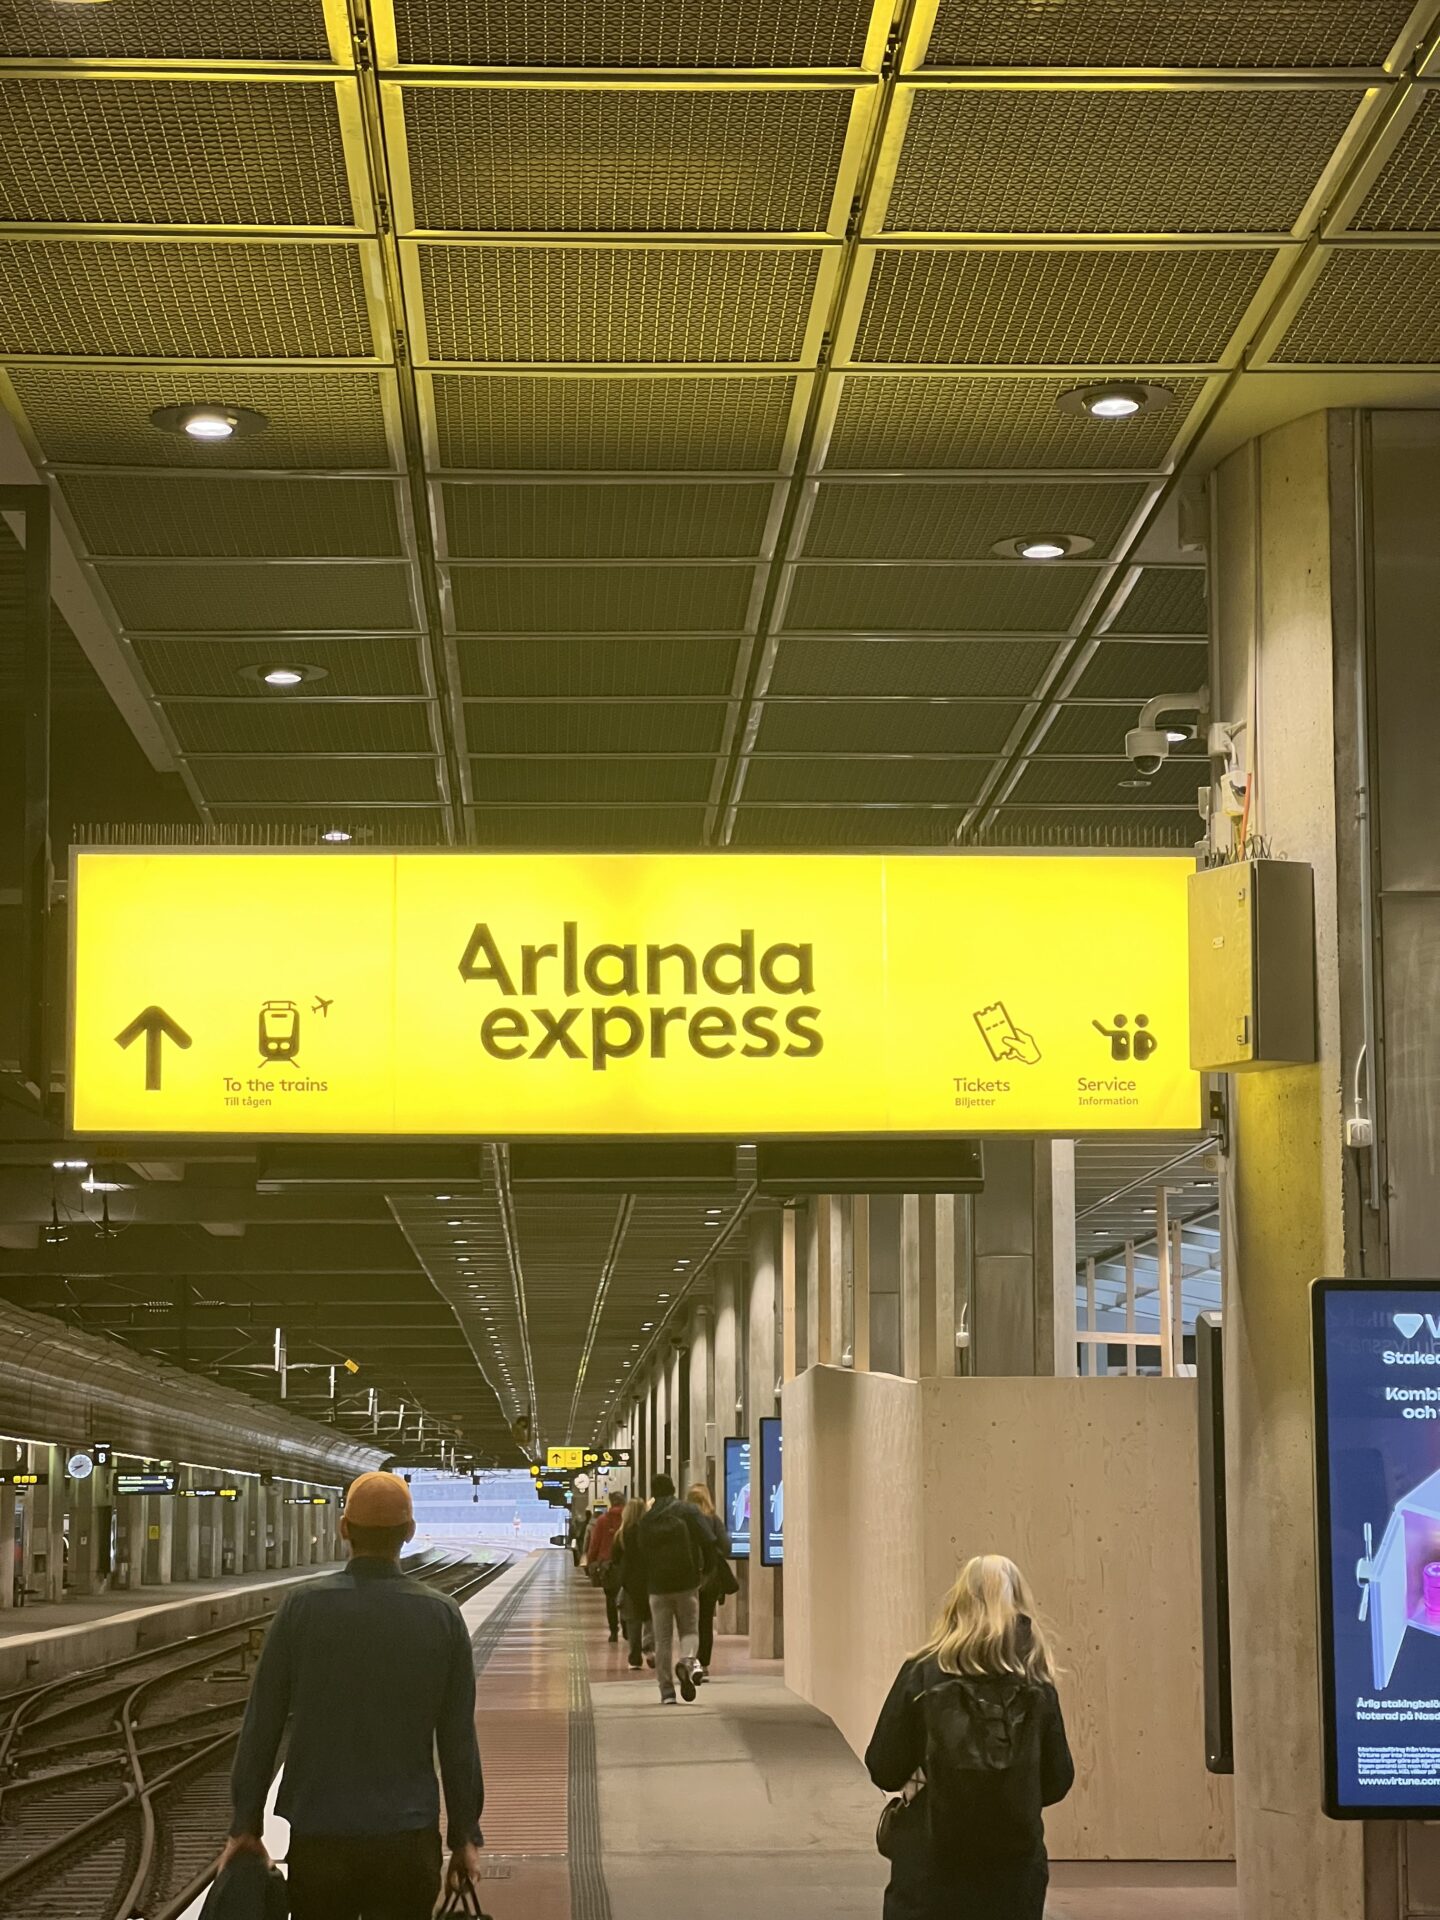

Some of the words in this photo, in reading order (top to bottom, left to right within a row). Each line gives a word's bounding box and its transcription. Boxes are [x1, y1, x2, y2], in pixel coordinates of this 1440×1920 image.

[457, 920, 816, 998] Arlanda
[480, 1005, 825, 1071] express
[223, 1077, 242, 1092] To
[246, 1078, 275, 1092] the
[279, 1076, 328, 1092] trains
[953, 1076, 1011, 1092] Tickets
[1077, 1076, 1136, 1092] Service
[224, 1096, 240, 1107] Till
[242, 1096, 272, 1108] tågen
[954, 1097, 996, 1108] Biljetter
[1078, 1096, 1139, 1106] Information
[1402, 1405, 1437, 1419] och
[1357, 1711, 1399, 1721] Noterad
[1400, 1711, 1414, 1722] på
